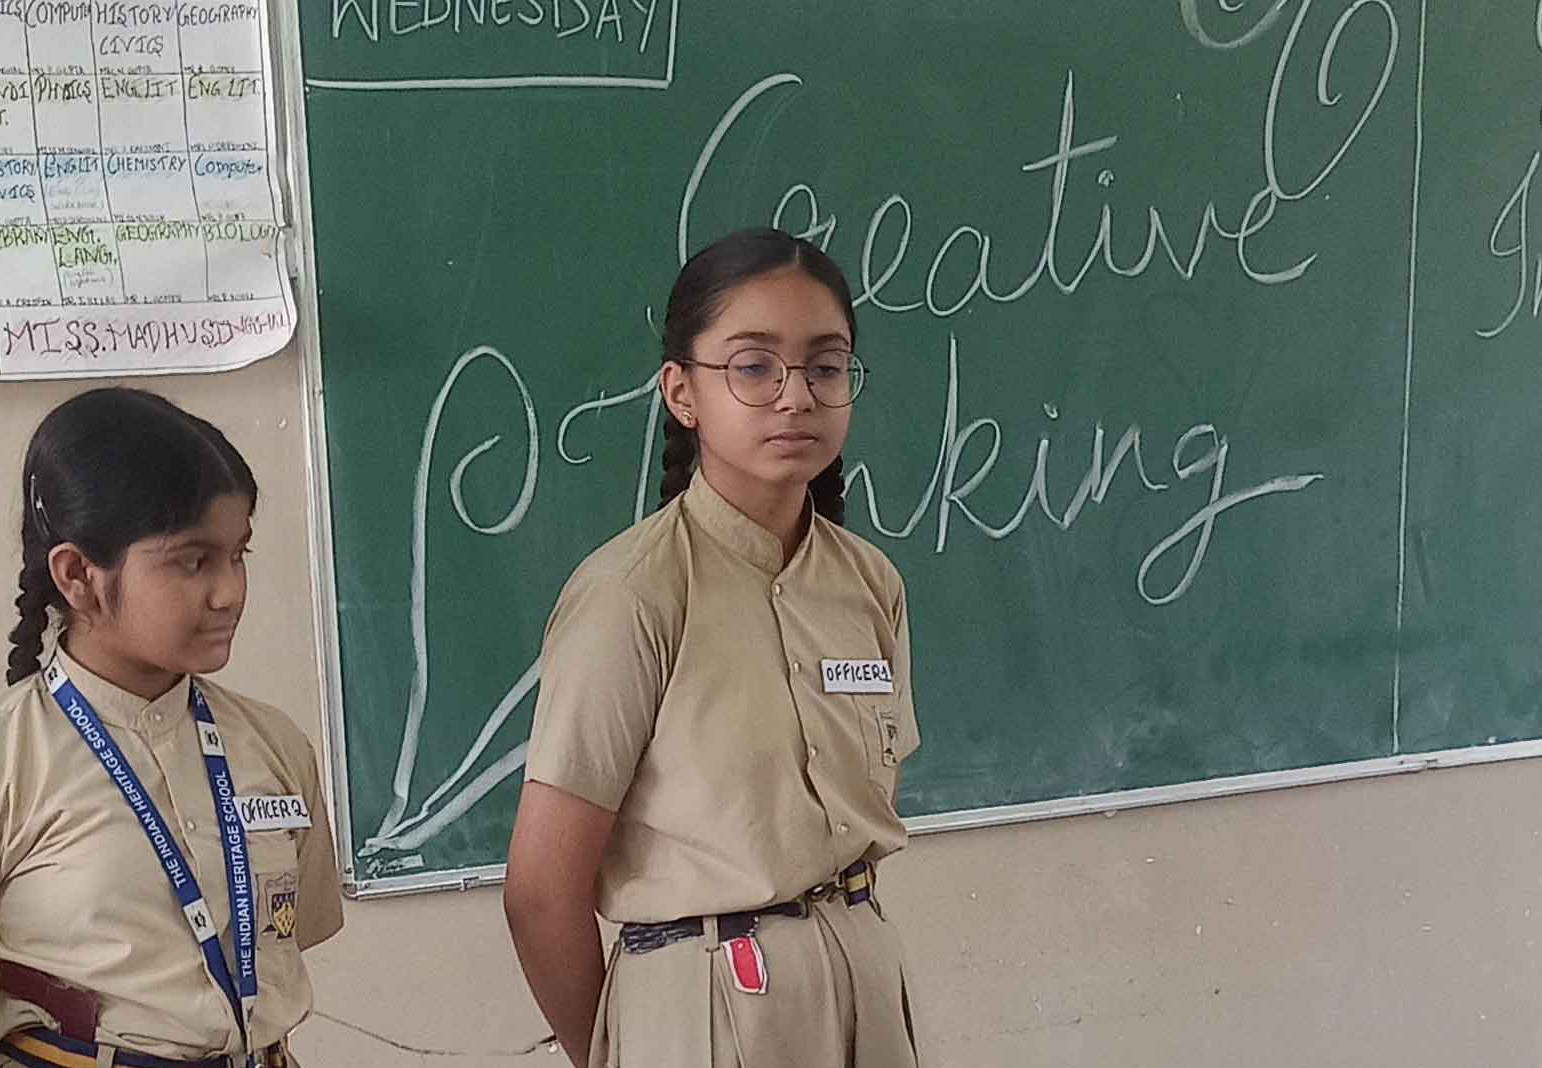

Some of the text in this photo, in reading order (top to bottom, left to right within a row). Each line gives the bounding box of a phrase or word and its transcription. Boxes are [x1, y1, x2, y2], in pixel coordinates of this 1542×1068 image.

[100, 35, 164, 57] CIVICS
[331, 0, 662, 53] WEDNESDAY
[34, 77, 93, 103] PHYSICS
[107, 154, 186, 175] CHEMISTRY
[66, 696, 187, 889] THE INDIAN HERITAGE SCHOOL
[215, 770, 253, 977] THE INDIAN HERITAGE SCHOOL
